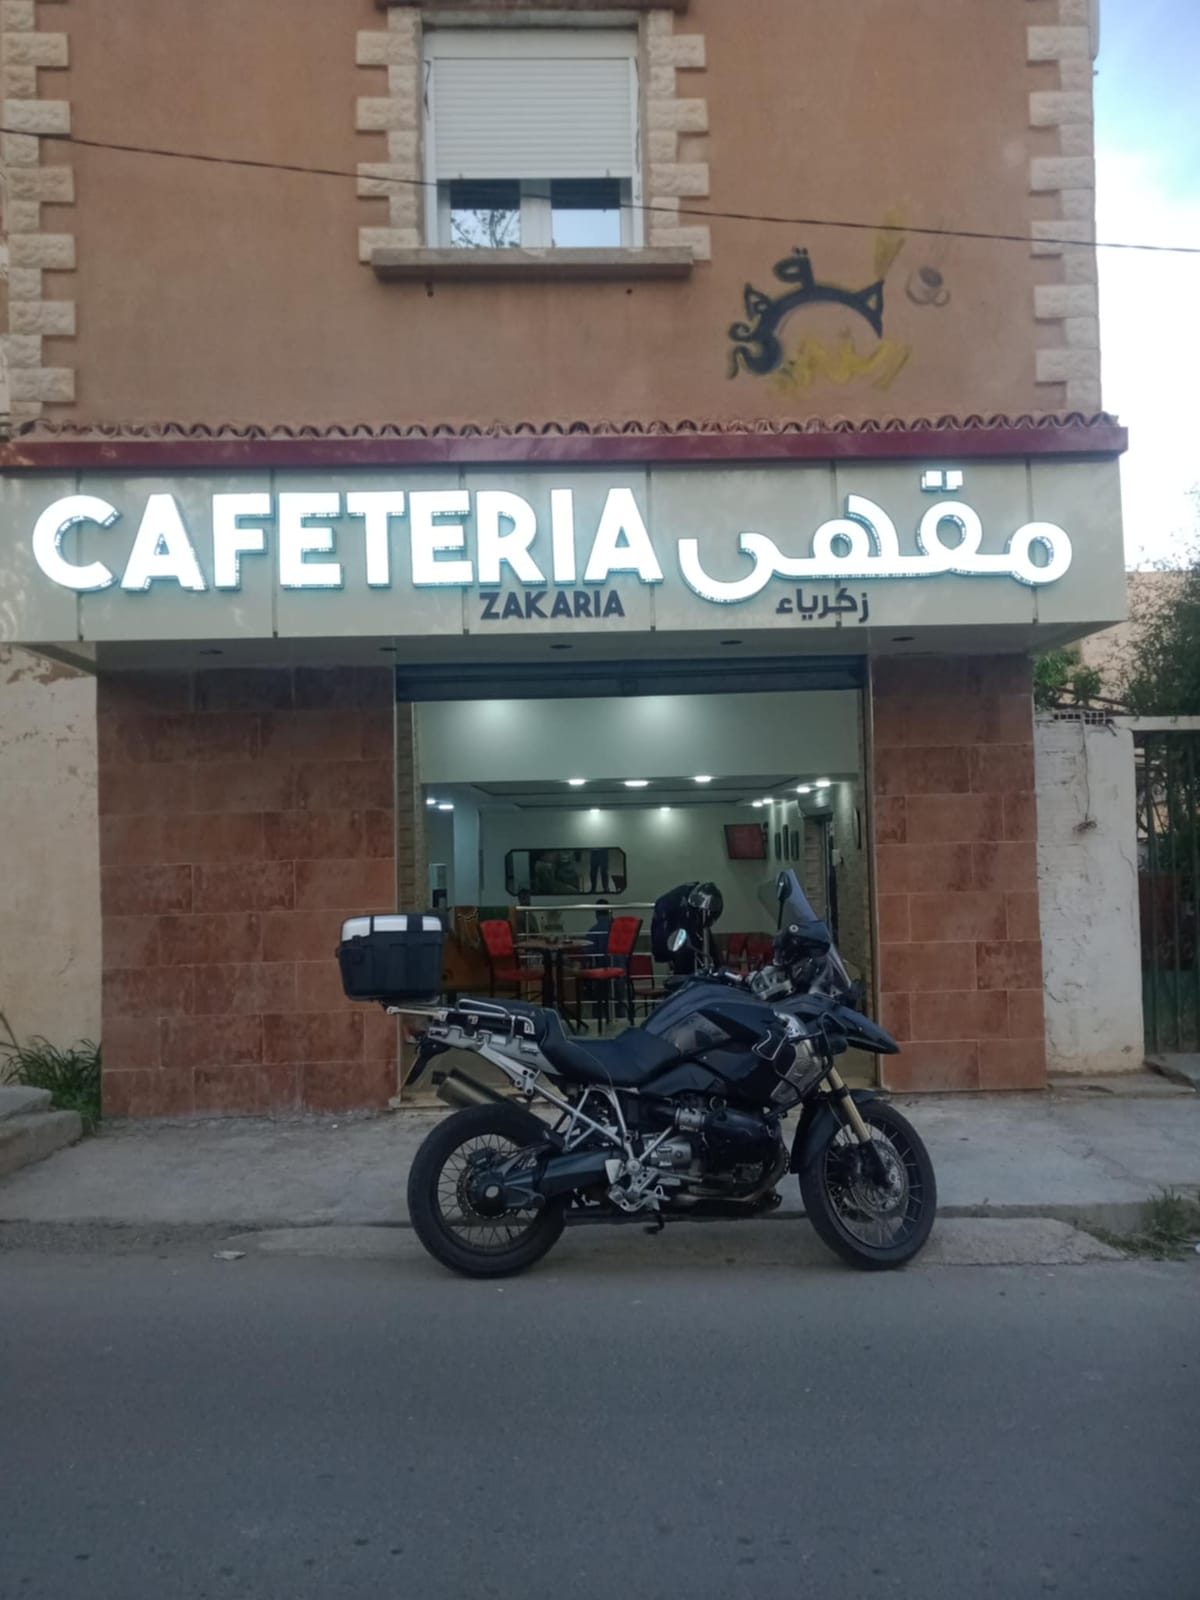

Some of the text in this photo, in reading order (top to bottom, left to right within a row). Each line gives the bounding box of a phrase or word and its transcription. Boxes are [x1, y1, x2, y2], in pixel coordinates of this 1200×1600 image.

[31, 486, 664, 592] CAFETERIA
[677, 469, 1073, 605] مقهى
[479, 588, 625, 621] ZAKARIA
[775, 586, 869, 622] زكرياء
